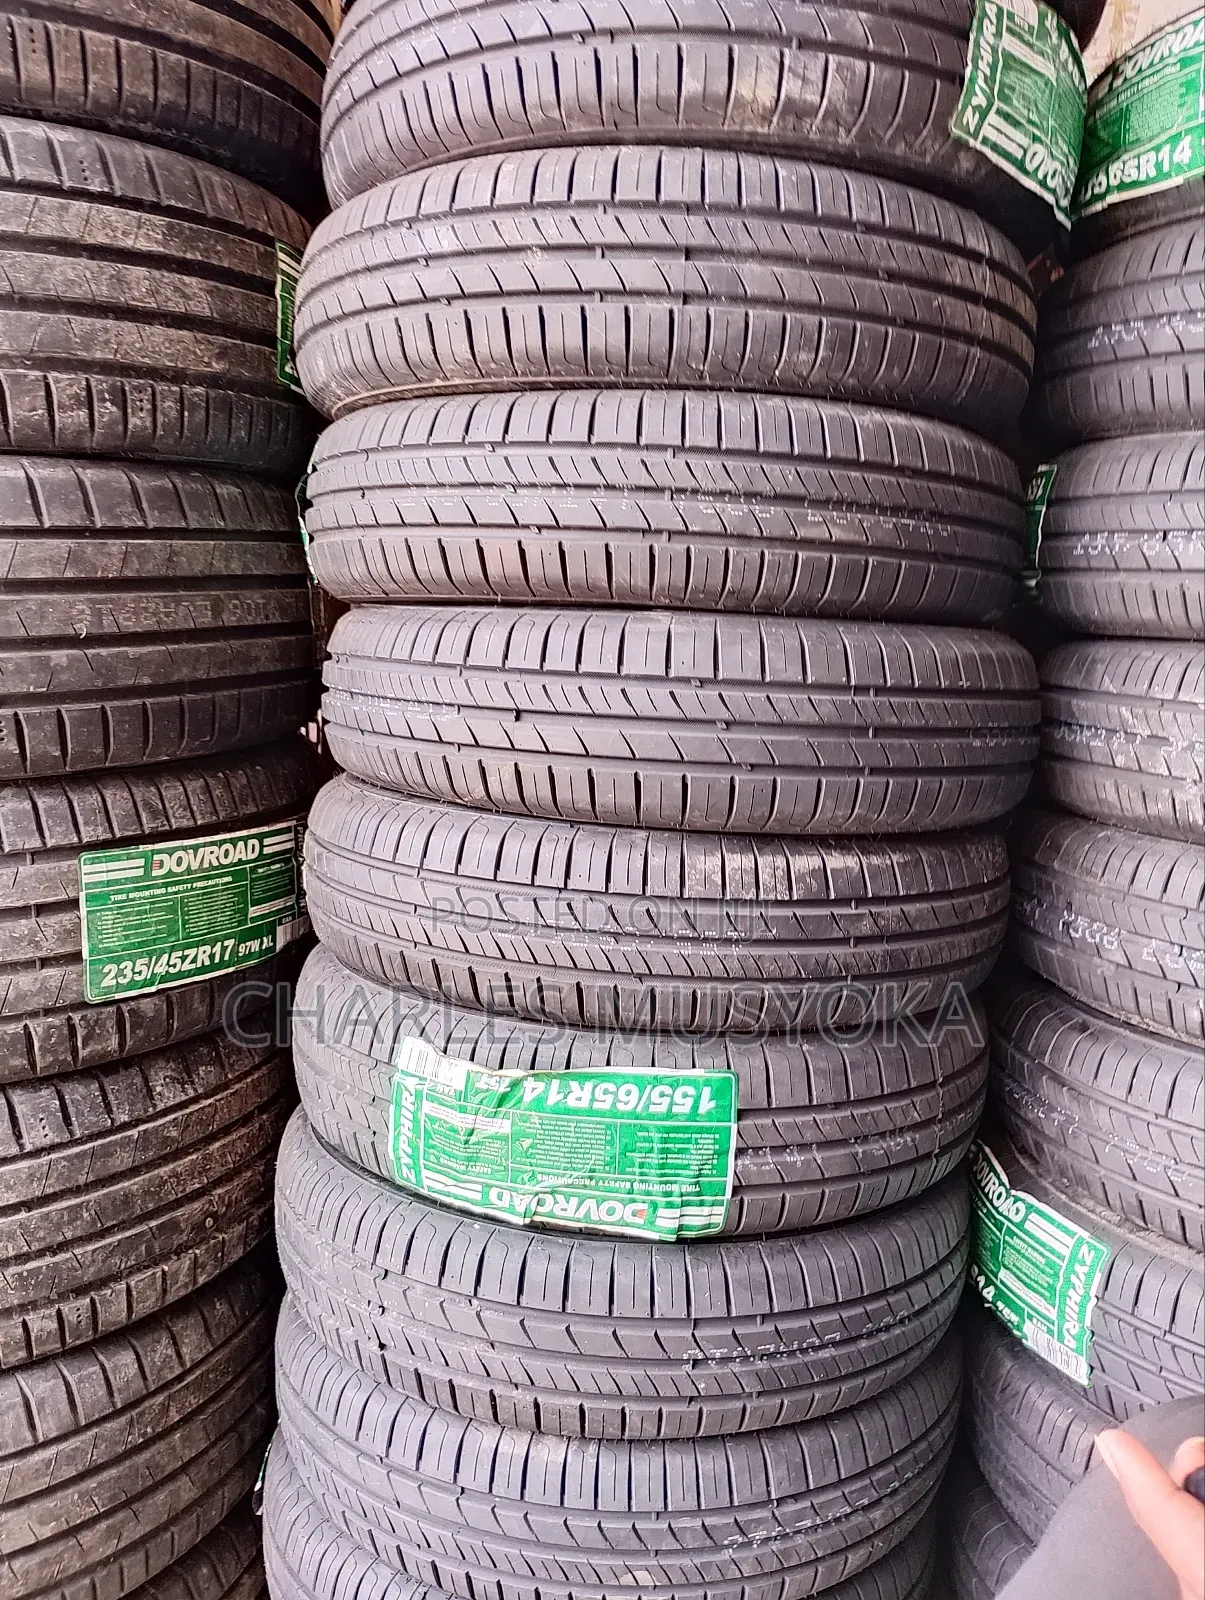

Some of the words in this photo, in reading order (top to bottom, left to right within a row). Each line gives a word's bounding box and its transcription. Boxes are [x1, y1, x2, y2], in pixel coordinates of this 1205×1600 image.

[962, 1, 998, 135] ZYPHIRA
[151, 838, 260, 877] DOVROAD
[109, 892, 128, 902] TIRE
[128, 887, 167, 899] MOUNTING
[167, 883, 192, 894] SAFETY
[192, 875, 233, 889] PRECAUTIONS
[100, 938, 236, 988] 235/45ZR17
[238, 938, 261, 957] 97W
[261, 934, 274, 951] XL
[522, 1077, 718, 1115] 155/65R14
[399, 1076, 418, 1185] ZYPHIRA
[537, 1173, 596, 1187] PRECAUTIONS
[598, 1178, 633, 1189] SAFETY
[633, 1181, 679, 1193] MOUNTING
[681, 1184, 700, 1194] TIRE
[488, 1186, 649, 1224] DOVROAD
[1063, 1243, 1096, 1350] ZYPHIRA
